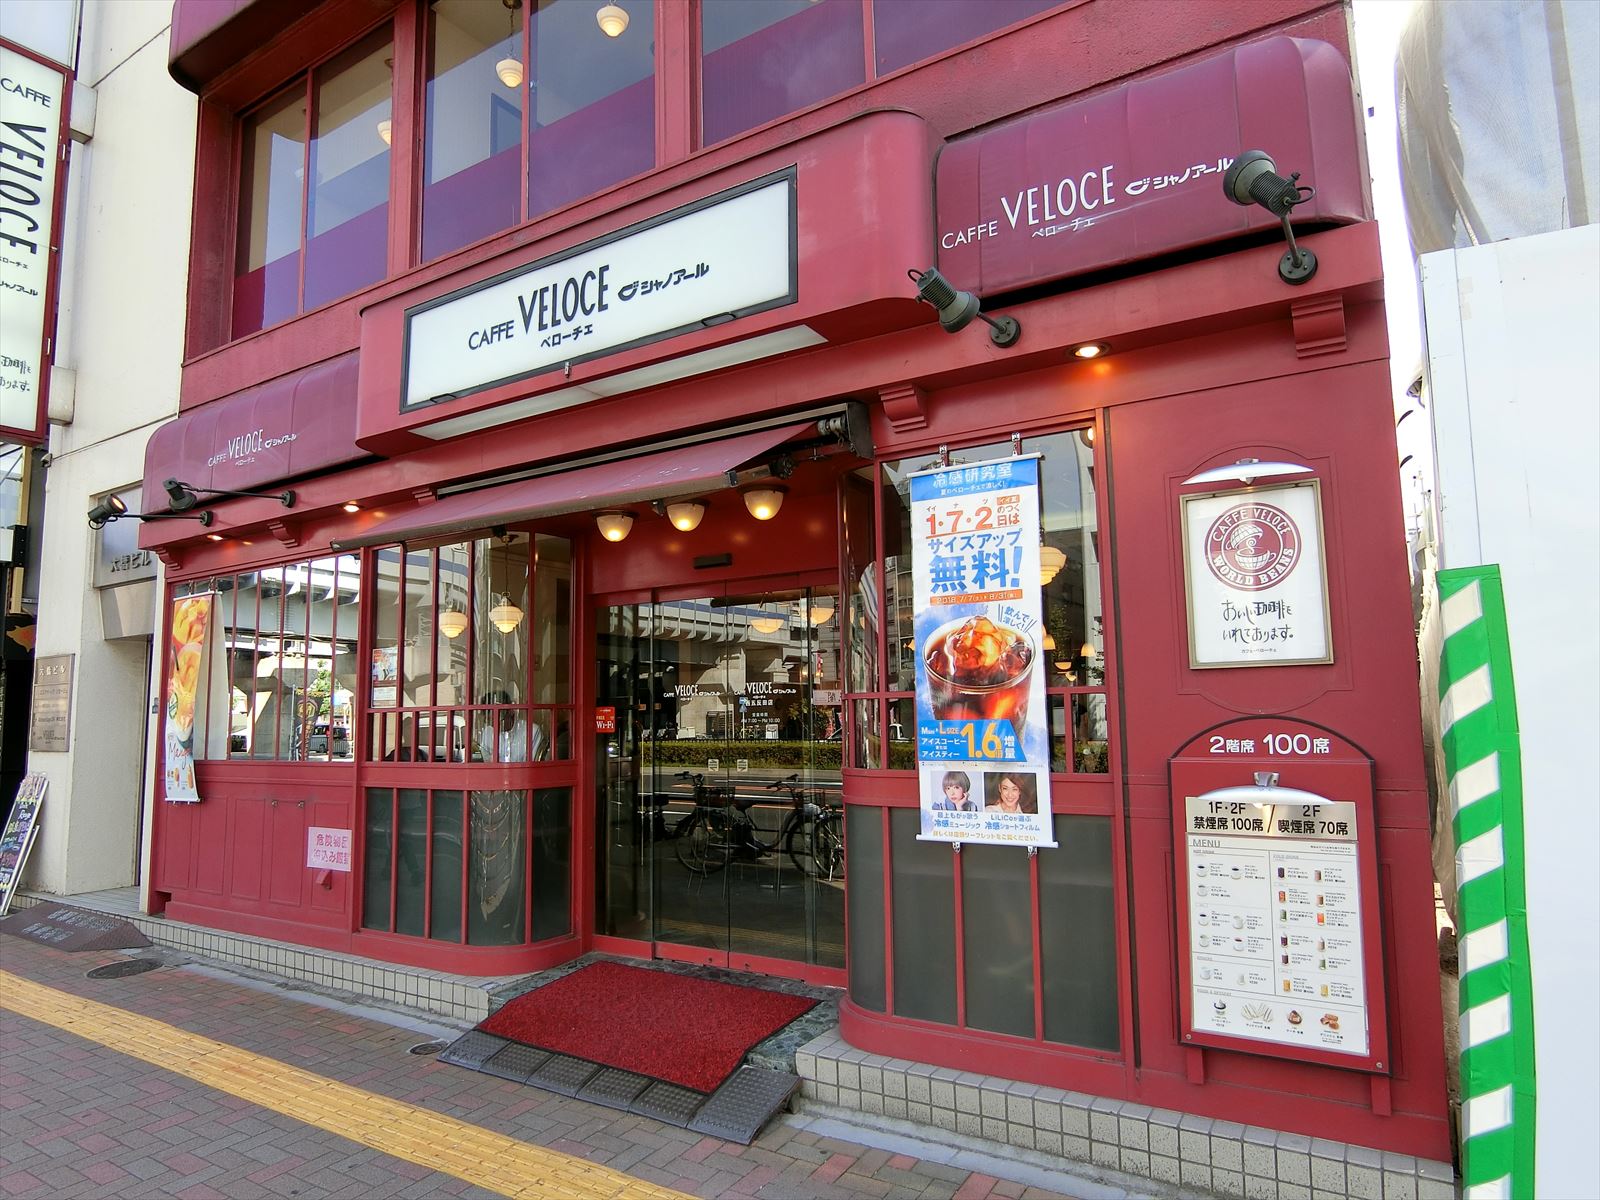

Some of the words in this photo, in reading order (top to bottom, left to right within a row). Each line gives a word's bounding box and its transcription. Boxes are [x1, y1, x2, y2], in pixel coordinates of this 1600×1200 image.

[0, 77, 52, 108] CAFFE
[941, 220, 999, 250] CAFFE
[1000, 164, 1116, 230] VELOCE
[1152, 157, 1234, 190] シャノアール
[1031, 217, 1096, 239] ベローチェ
[0, 256, 29, 269] ローチェ
[468, 320, 515, 350] CAFFE
[518, 265, 610, 335] VELOCE
[640, 262, 710, 296] シャノアール
[540, 323, 594, 349] ベローチェ
[208, 454, 227, 467] CAFFE
[227, 428, 264, 459] VELOCE
[933, 463, 1013, 488] 冷感研究室
[997, 504, 1020, 514] のつく
[997, 513, 1020, 526] 日は
[1213, 509, 1248, 542] CAFFE
[1252, 508, 1291, 535] VELOCE
[928, 528, 1023, 554] サイズアップ
[929, 546, 1023, 593] 無料!
[1213, 555, 1254, 585] WORLD
[1258, 548, 1294, 585] BEANS
[1004, 606, 1030, 623] 飲んで
[1221, 599, 1293, 625] おいしい珈琲を
[1222, 623, 1294, 644] いれております。
[674, 684, 699, 696] VELOCE
[746, 681, 773, 694] VELOCE
[922, 750, 960, 758] アイスティー
[1209, 736, 1255, 754] 2階席
[1262, 733, 1331, 755] 100席
[1302, 805, 1321, 818] 2F
[934, 819, 981, 829] 冷感ミュージック
[985, 821, 1040, 831] 冷感ショートフィルム
[1193, 816, 1229, 831] 禁煙席
[1231, 818, 1264, 832] 100席
[1278, 820, 1315, 835] 喫煙席
[1319, 821, 1349, 836] 70席
[1192, 839, 1221, 848] MENU
